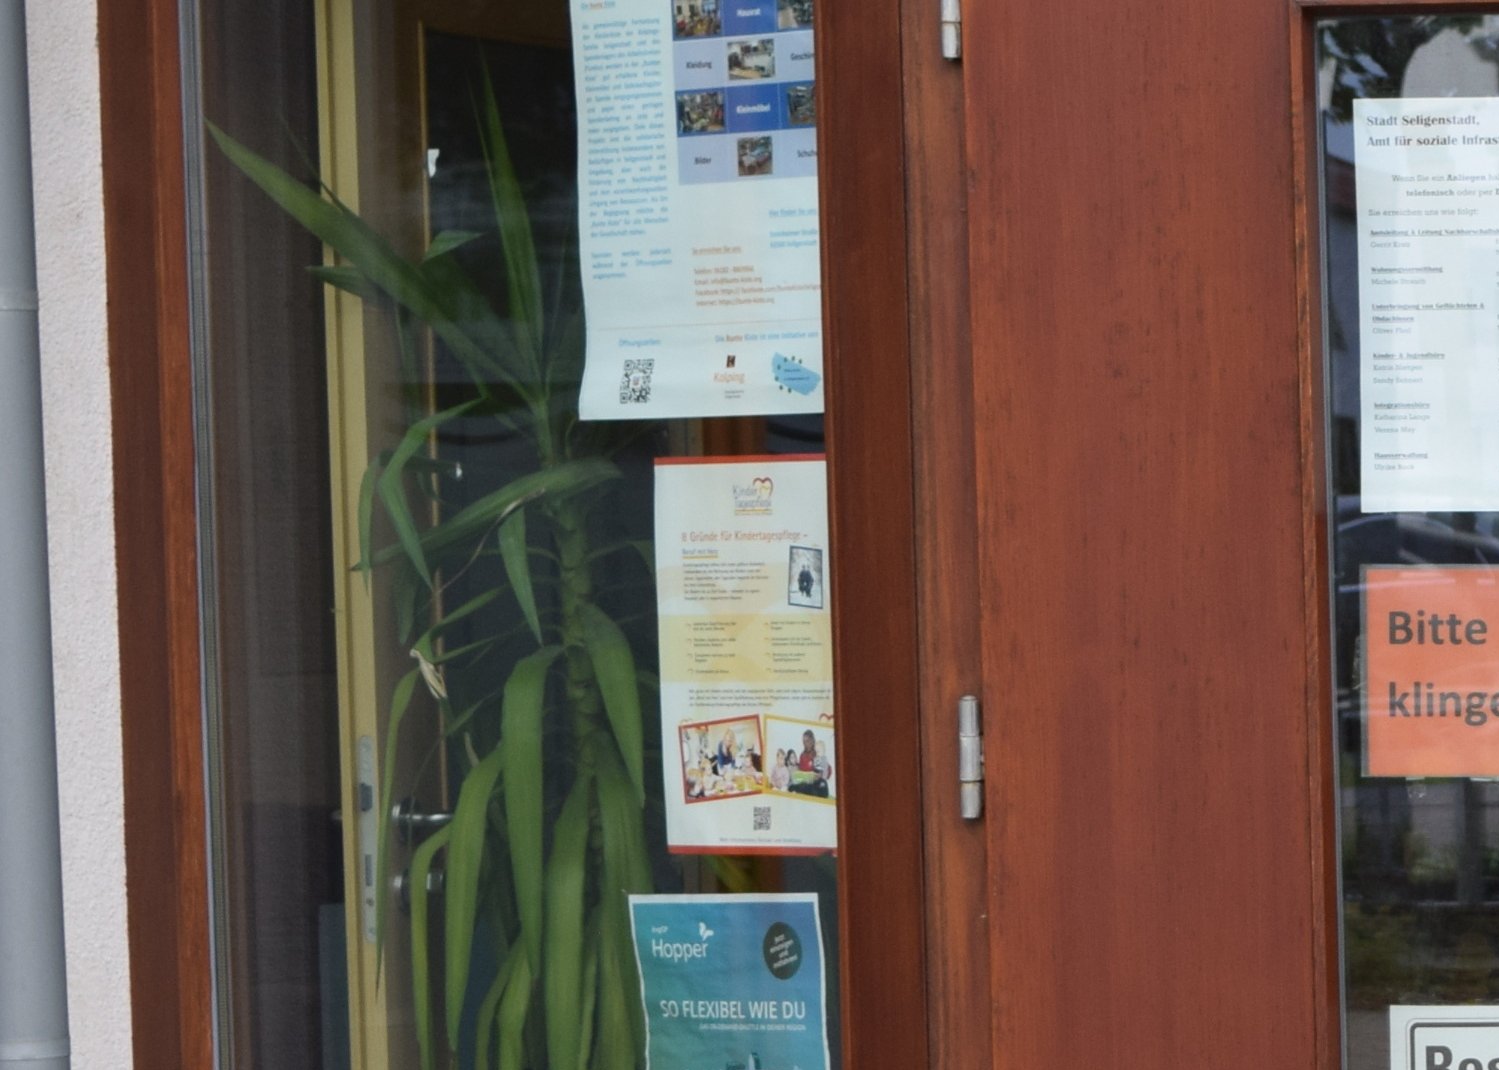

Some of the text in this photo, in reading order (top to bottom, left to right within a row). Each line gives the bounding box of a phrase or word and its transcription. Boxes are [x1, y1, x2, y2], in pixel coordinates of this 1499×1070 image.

[1366, 114, 1480, 128] Stadt Seligenstadt,
[1366, 136, 1391, 147] Amt
[1394, 135, 1413, 147] für
[1416, 134, 1458, 146] soziale
[1447, 173, 1487, 183] Anliegen
[1406, 189, 1455, 197] telefonisch
[1388, 610, 1488, 645] Bitte
[651, 939, 709, 964] Hopper
[659, 1000, 806, 1020] SO FLEXIBEL WIE DU
